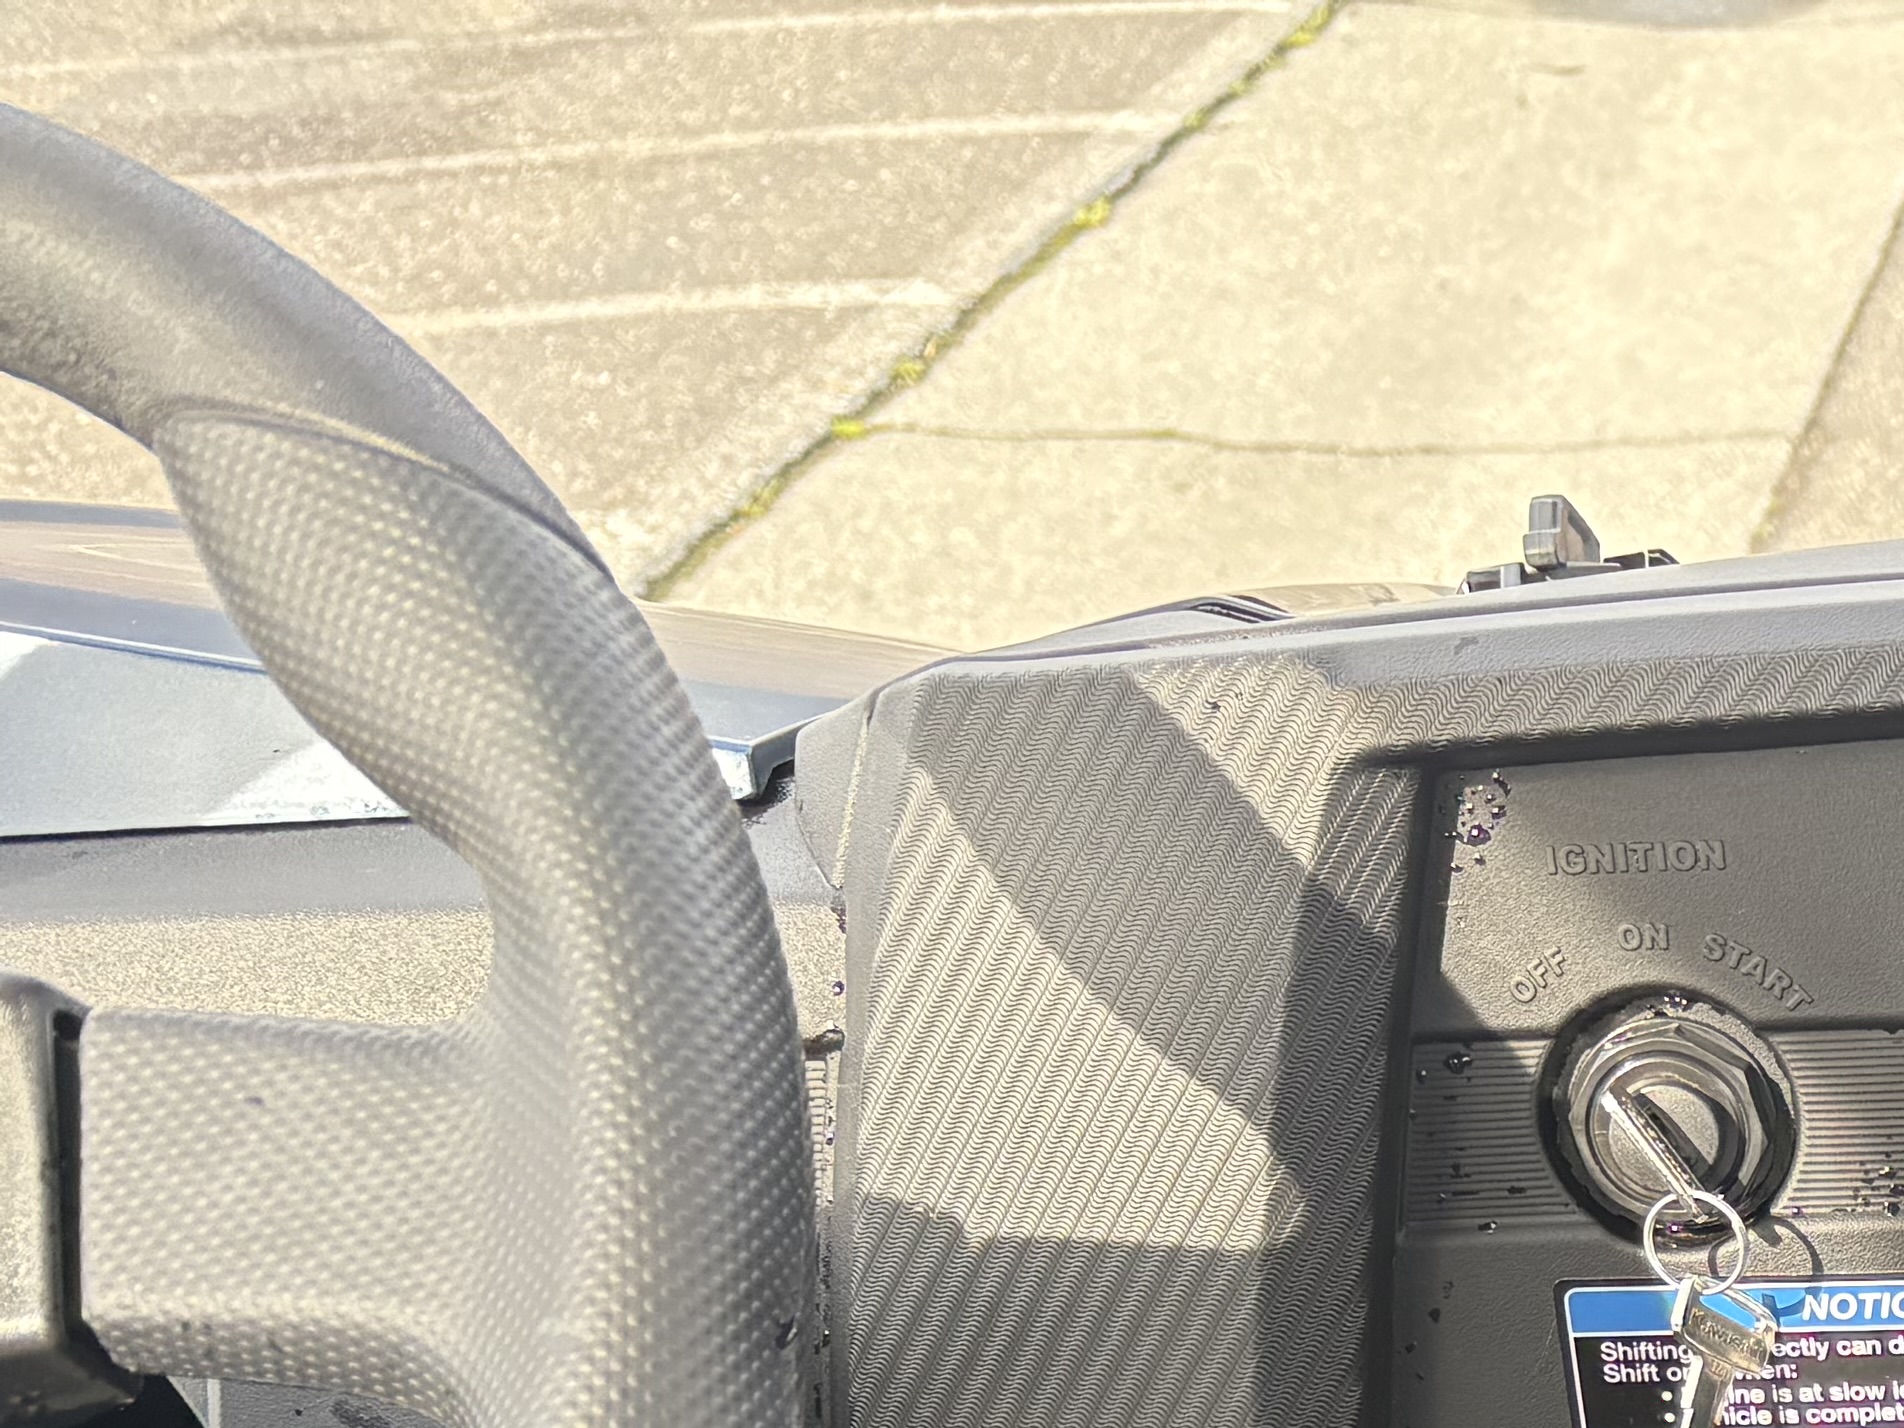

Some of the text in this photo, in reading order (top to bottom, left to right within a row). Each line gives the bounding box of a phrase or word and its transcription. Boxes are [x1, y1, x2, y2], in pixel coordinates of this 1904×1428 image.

[1545, 839, 1727, 876] IGNITION
[1616, 922, 1670, 953] ON
[1509, 945, 1569, 1003] OFF
[1703, 933, 1813, 1012] START
[1600, 1339, 1693, 1364] Shifting
[1835, 1337, 1882, 1356] can
[1602, 1362, 1661, 1384] Shift
[1772, 1385, 1793, 1404] is
[1799, 1385, 1823, 1403] at
[1828, 1383, 1885, 1402] slow
[1778, 1406, 1799, 1425] is
